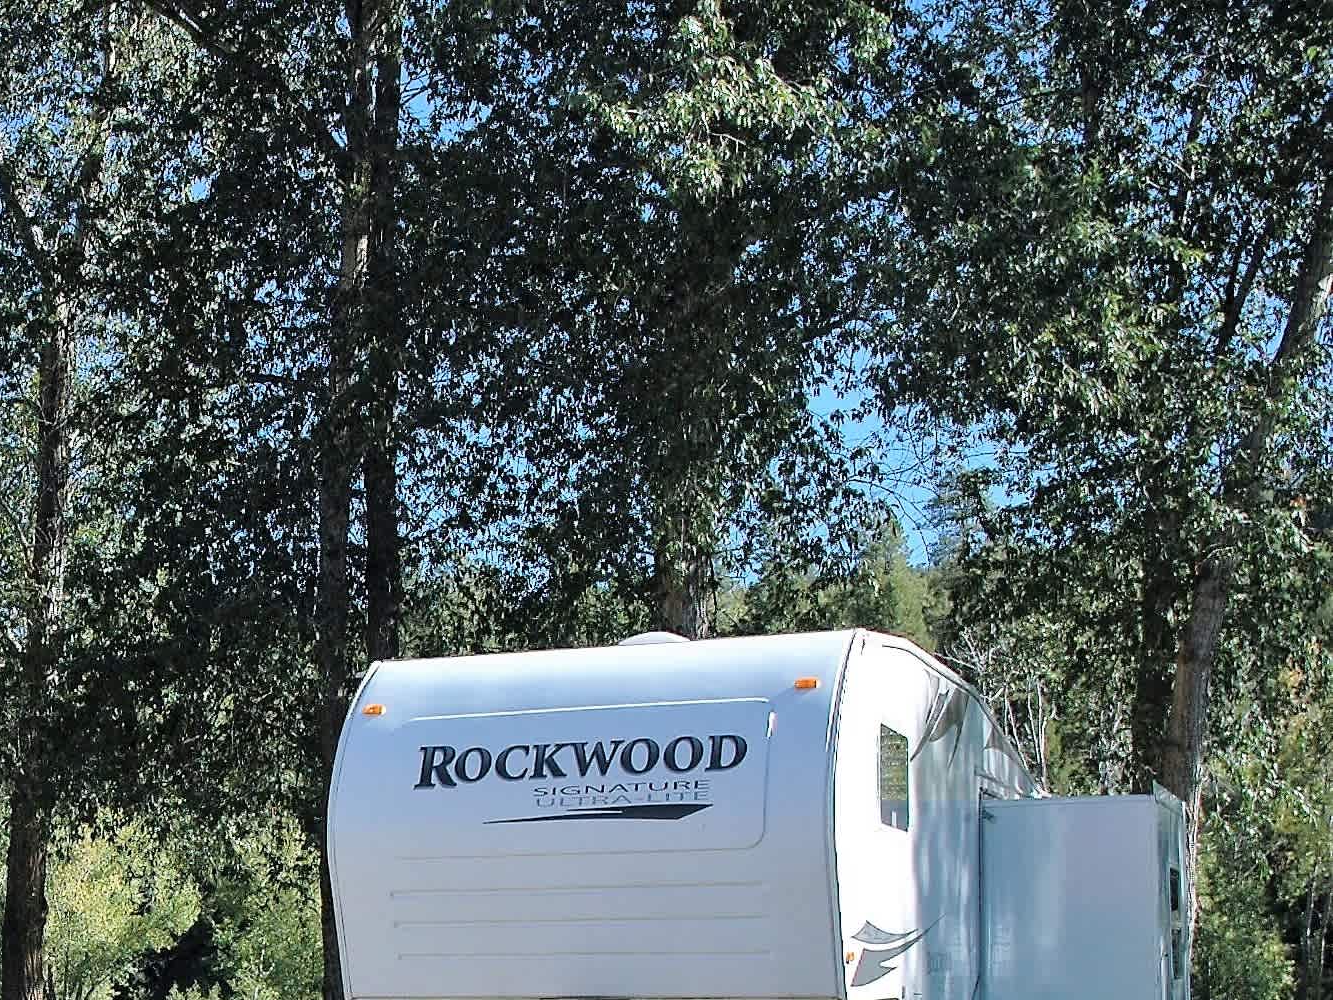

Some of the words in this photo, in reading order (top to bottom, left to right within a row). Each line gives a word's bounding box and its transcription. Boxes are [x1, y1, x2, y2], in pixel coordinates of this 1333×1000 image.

[414, 734, 748, 790] ROCKWOOD
[533, 780, 711, 796] SIGNATURE
[536, 791, 710, 807] ULTRA-LITE
